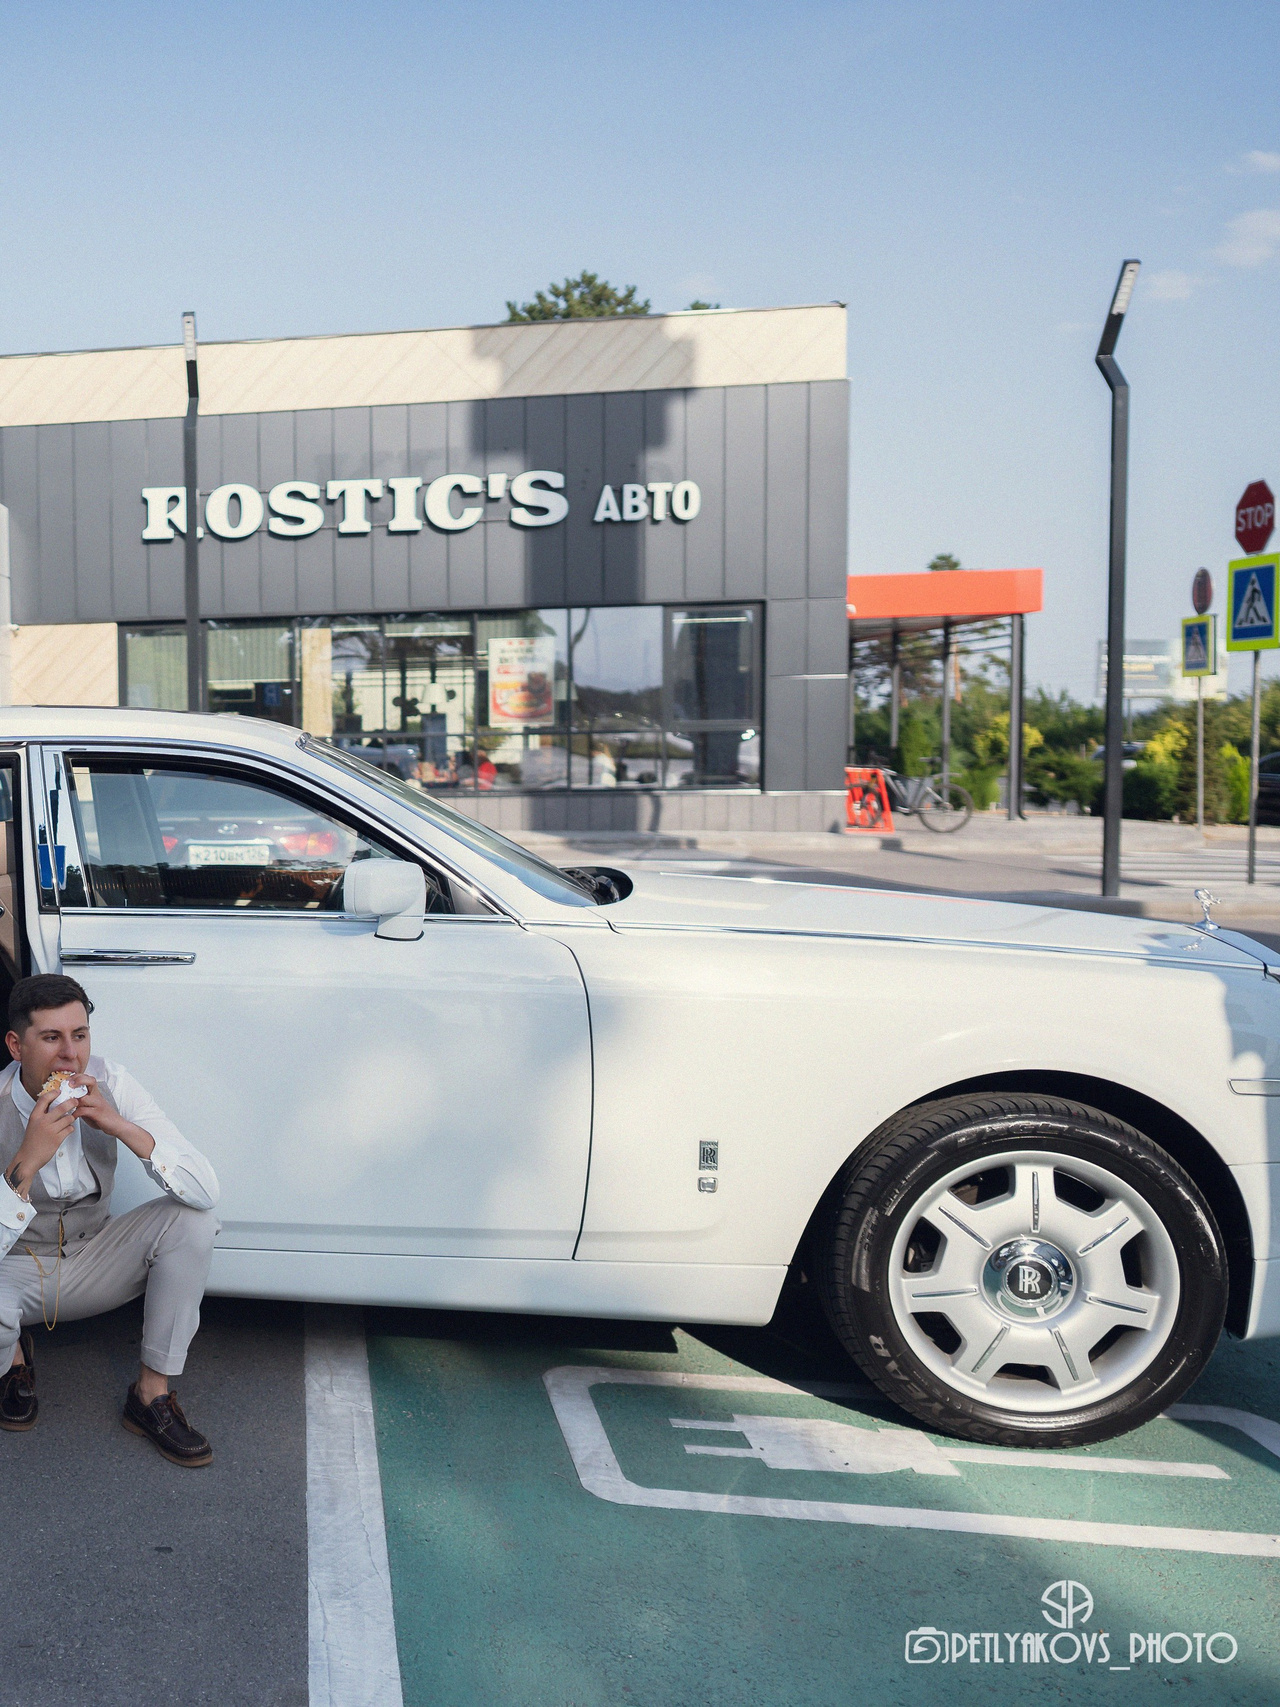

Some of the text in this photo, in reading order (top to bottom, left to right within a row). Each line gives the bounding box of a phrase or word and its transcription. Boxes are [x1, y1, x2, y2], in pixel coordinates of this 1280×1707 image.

[142, 469, 702, 541] ROSTIC'S АВТО
[1237, 503, 1274, 531] STOP
